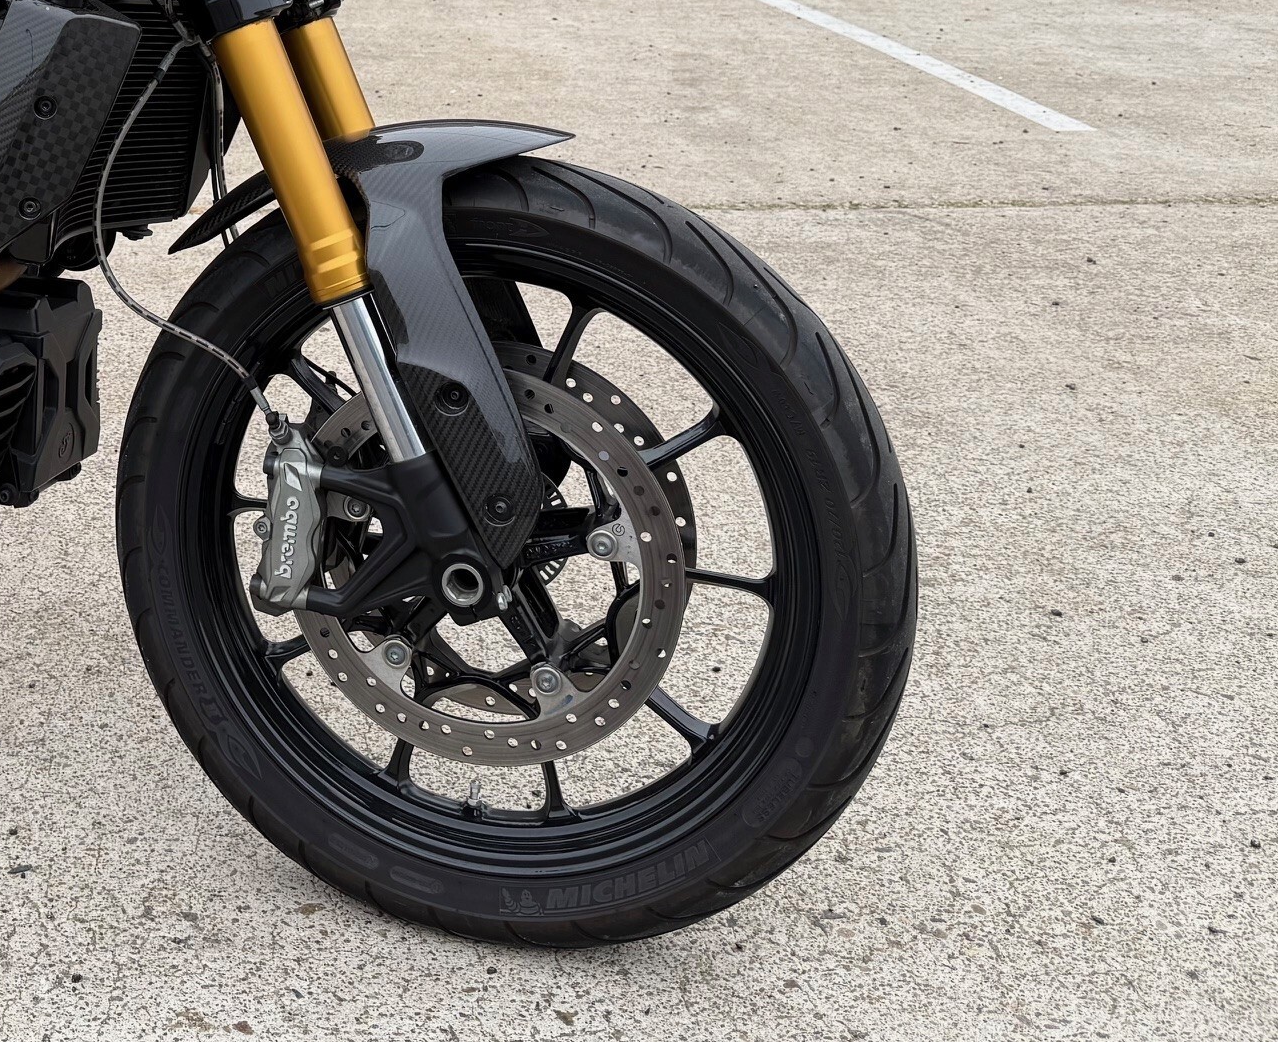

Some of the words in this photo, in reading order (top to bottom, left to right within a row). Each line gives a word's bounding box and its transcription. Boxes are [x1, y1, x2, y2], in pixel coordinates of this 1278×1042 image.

[274, 496, 300, 579] brembo
[156, 560, 209, 697] COMMANDER
[545, 839, 712, 911] MICHELIN
